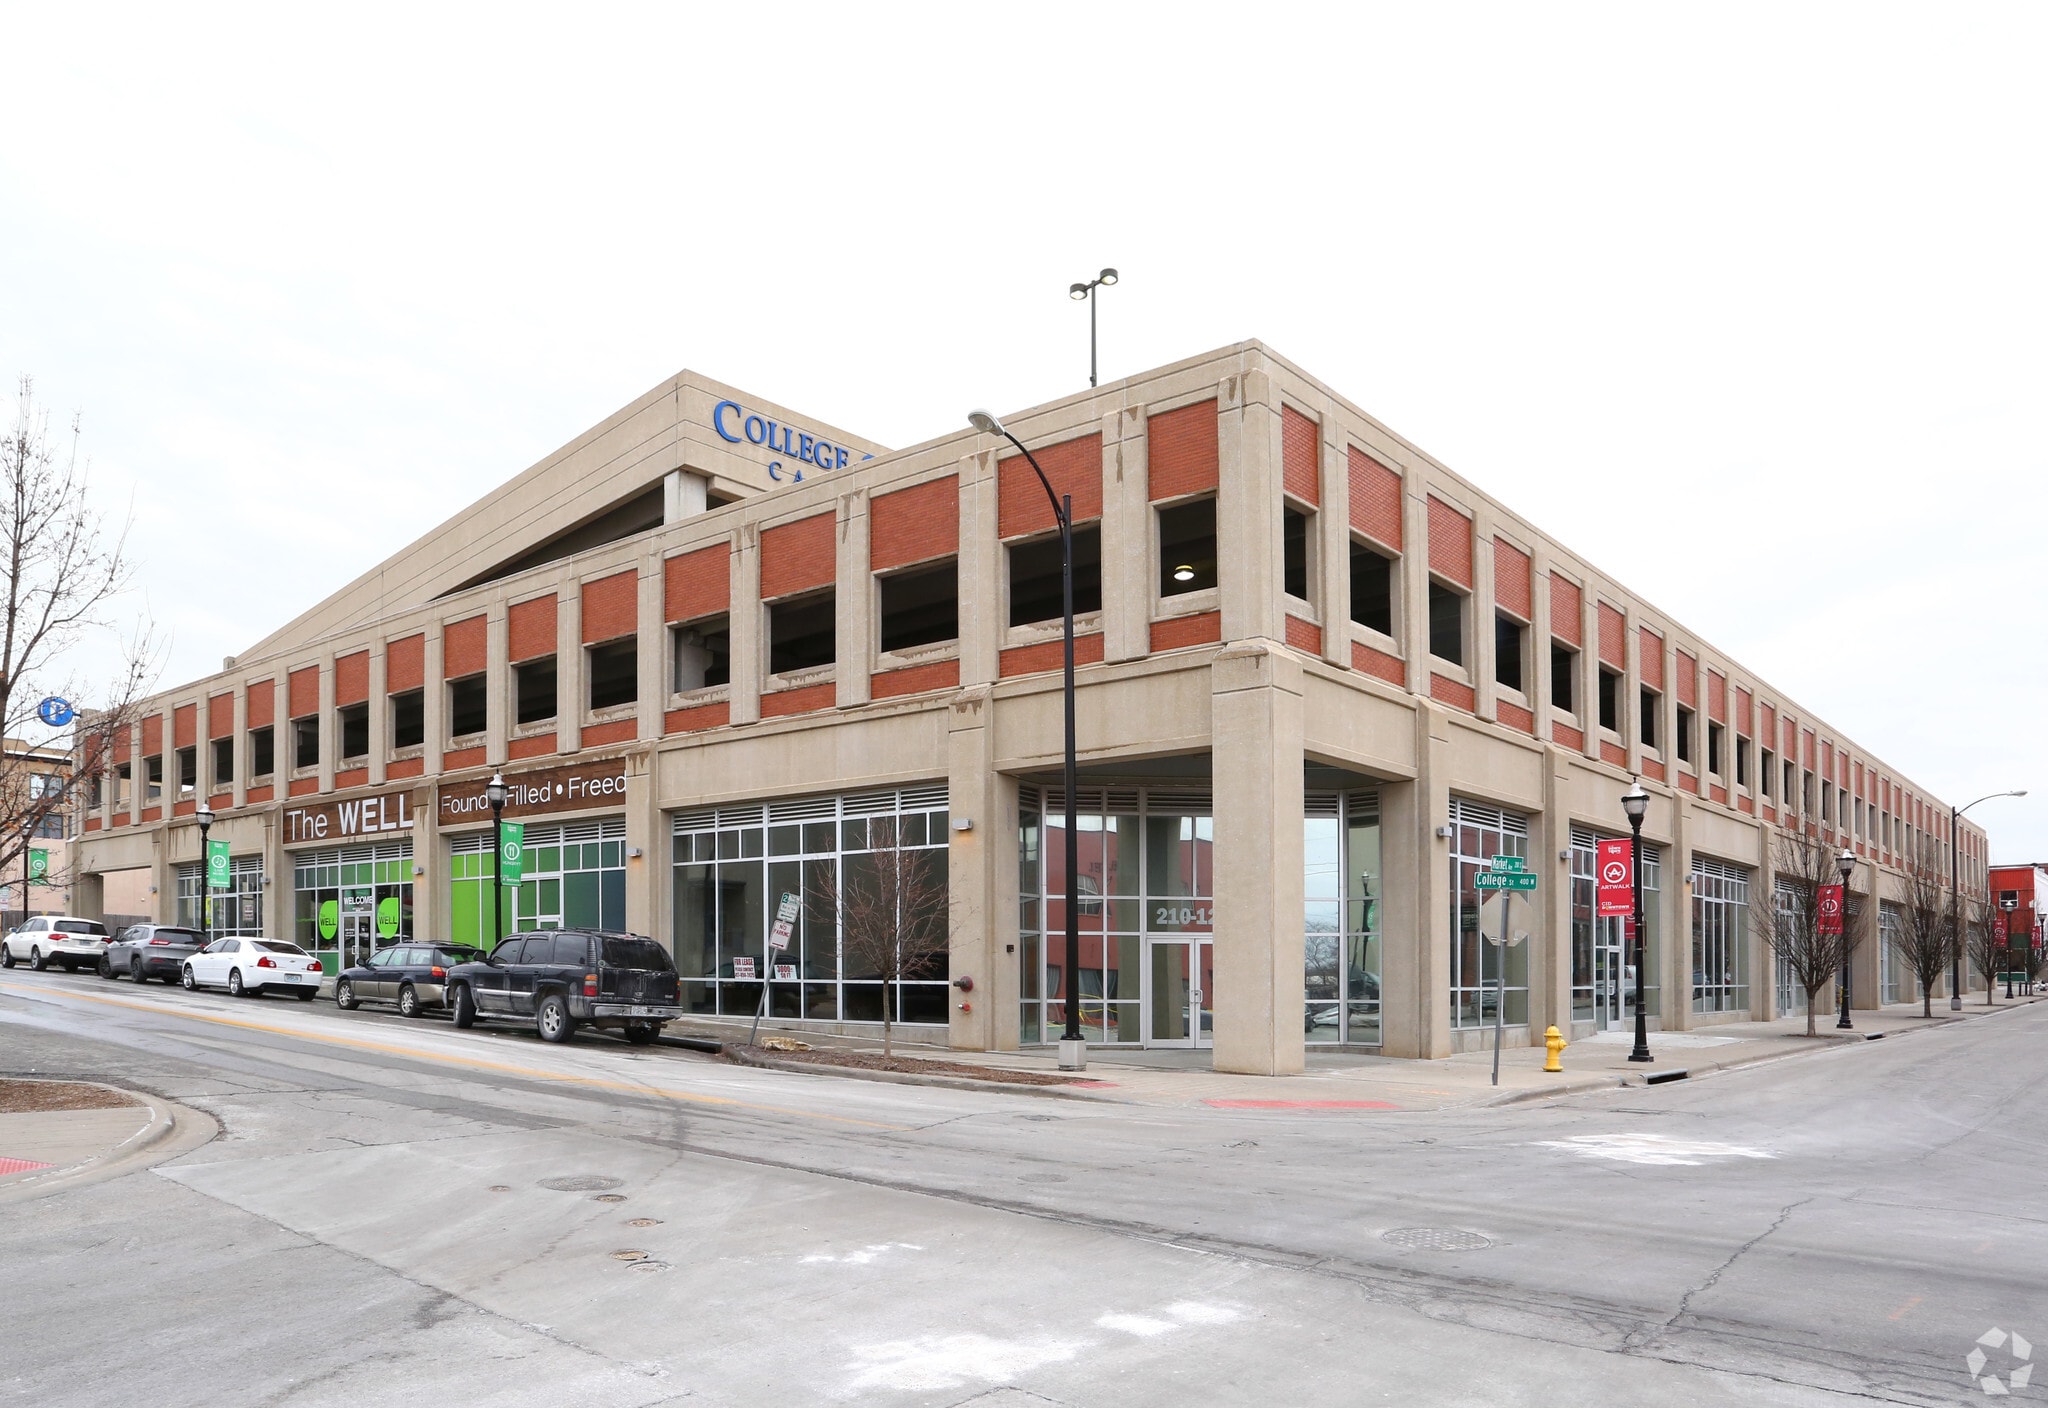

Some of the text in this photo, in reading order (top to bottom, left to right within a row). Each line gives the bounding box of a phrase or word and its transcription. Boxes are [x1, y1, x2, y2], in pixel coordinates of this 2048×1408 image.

[441, 769, 627, 815] Found Filled Freed
[286, 794, 414, 841] The WELL
[1492, 857, 1508, 870] Market
[1476, 873, 1507, 889] College
[344, 896, 373, 905] WELCOME
[782, 893, 789, 903] 2
[320, 917, 336, 926] WELL
[378, 916, 398, 924] WELL
[773, 929, 790, 938] PARKING
